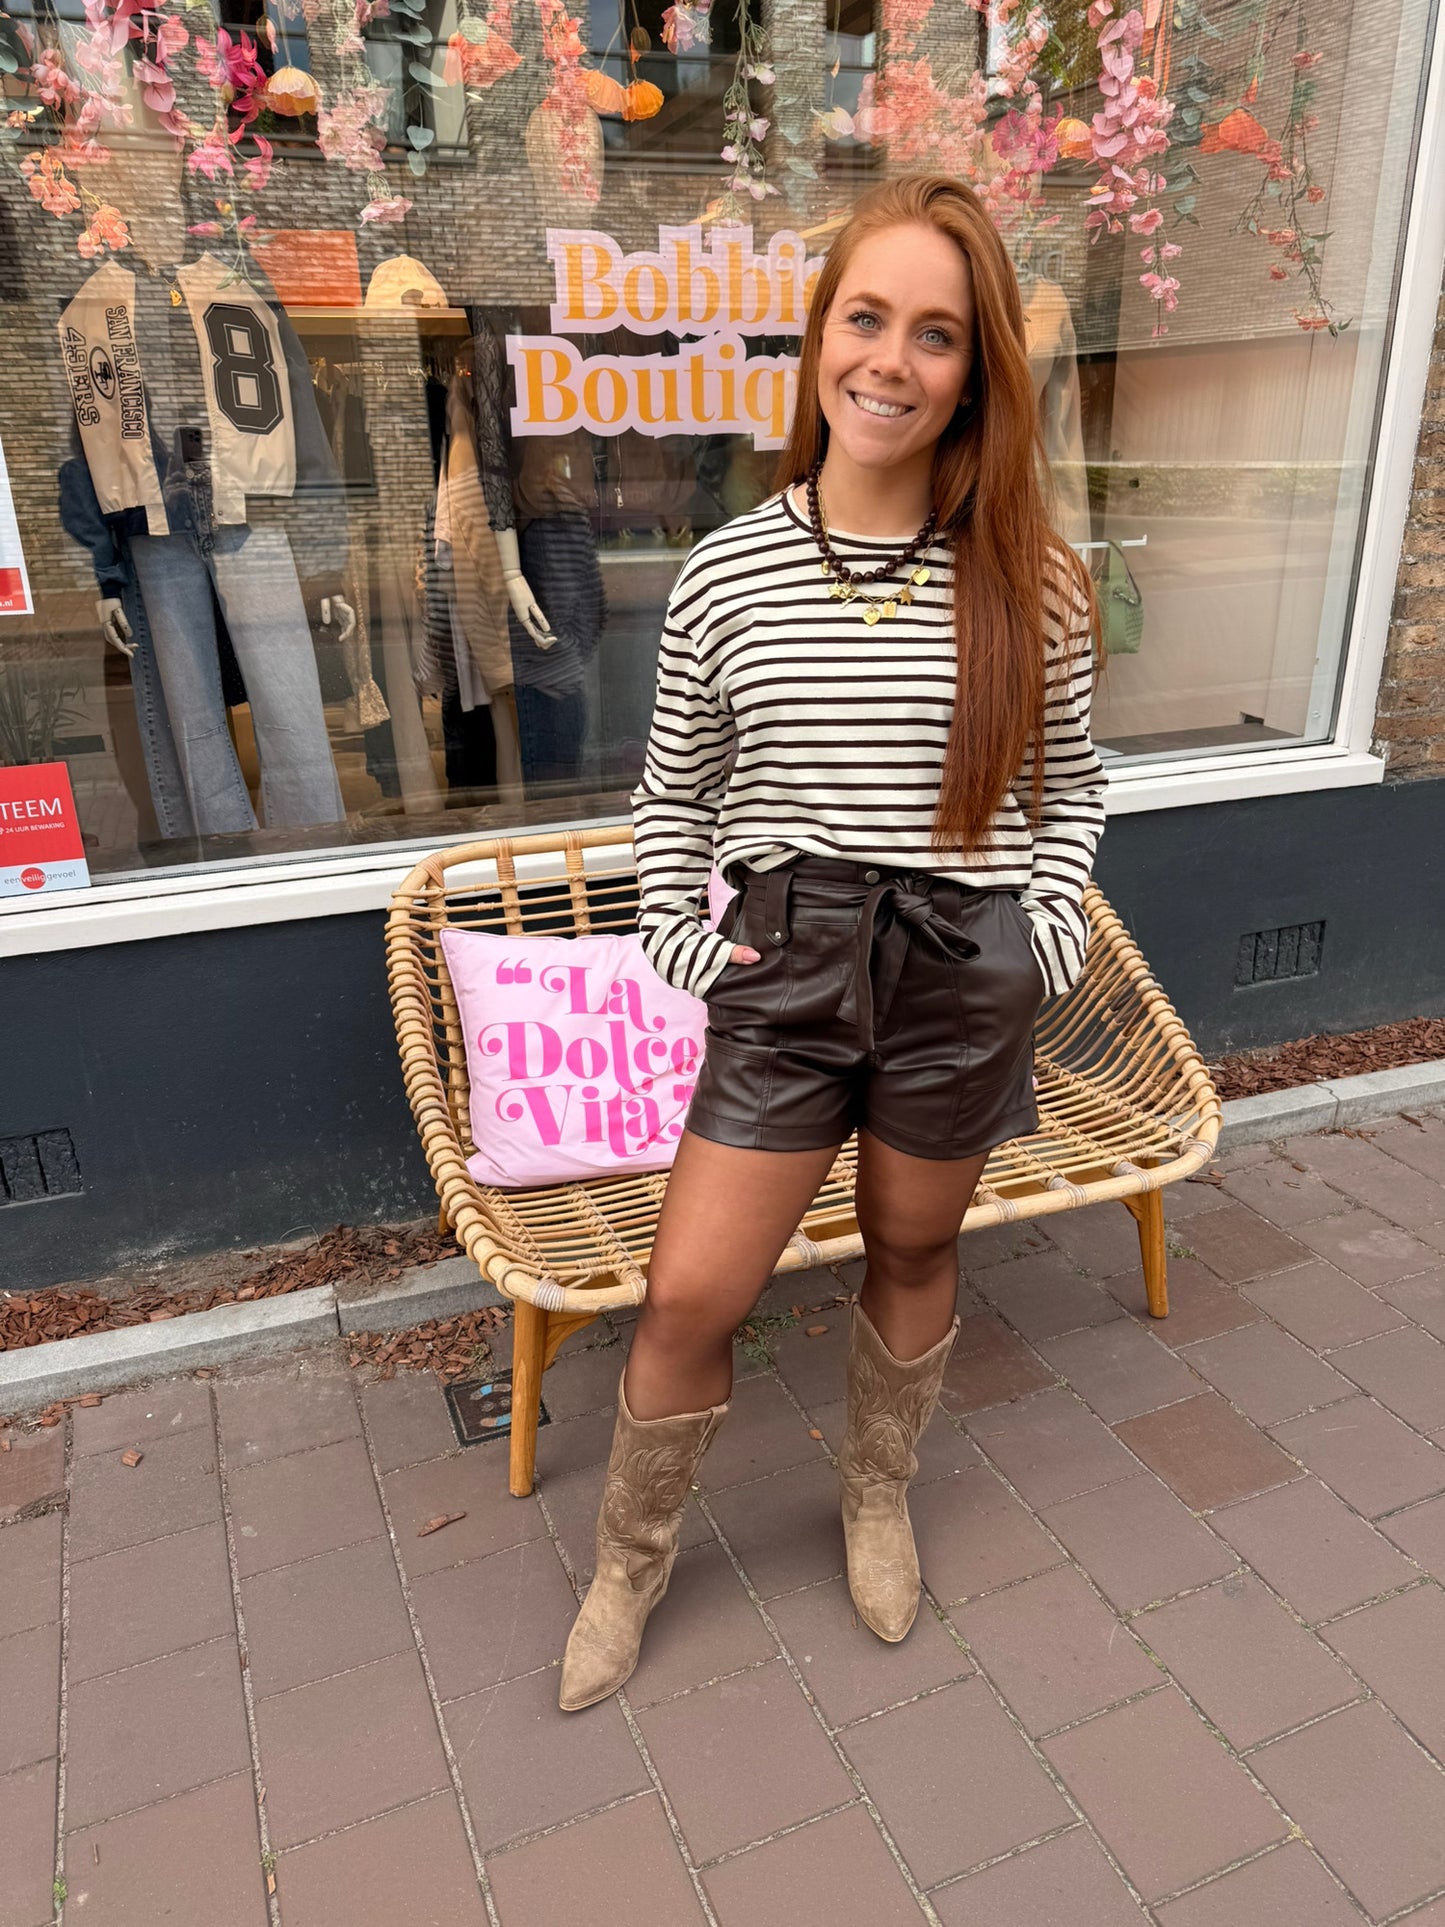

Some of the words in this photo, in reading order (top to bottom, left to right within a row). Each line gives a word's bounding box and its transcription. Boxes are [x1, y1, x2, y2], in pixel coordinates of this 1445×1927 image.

[105, 304, 133, 341] SAN
[203, 302, 285, 436] 8
[61, 327, 100, 427] 49ERS
[110, 343, 145, 440] FRANCISCO
[518, 343, 800, 439] Boutiq
[30, 822, 65, 831] BEWAKING
[477, 1020, 699, 1096] Dolce
